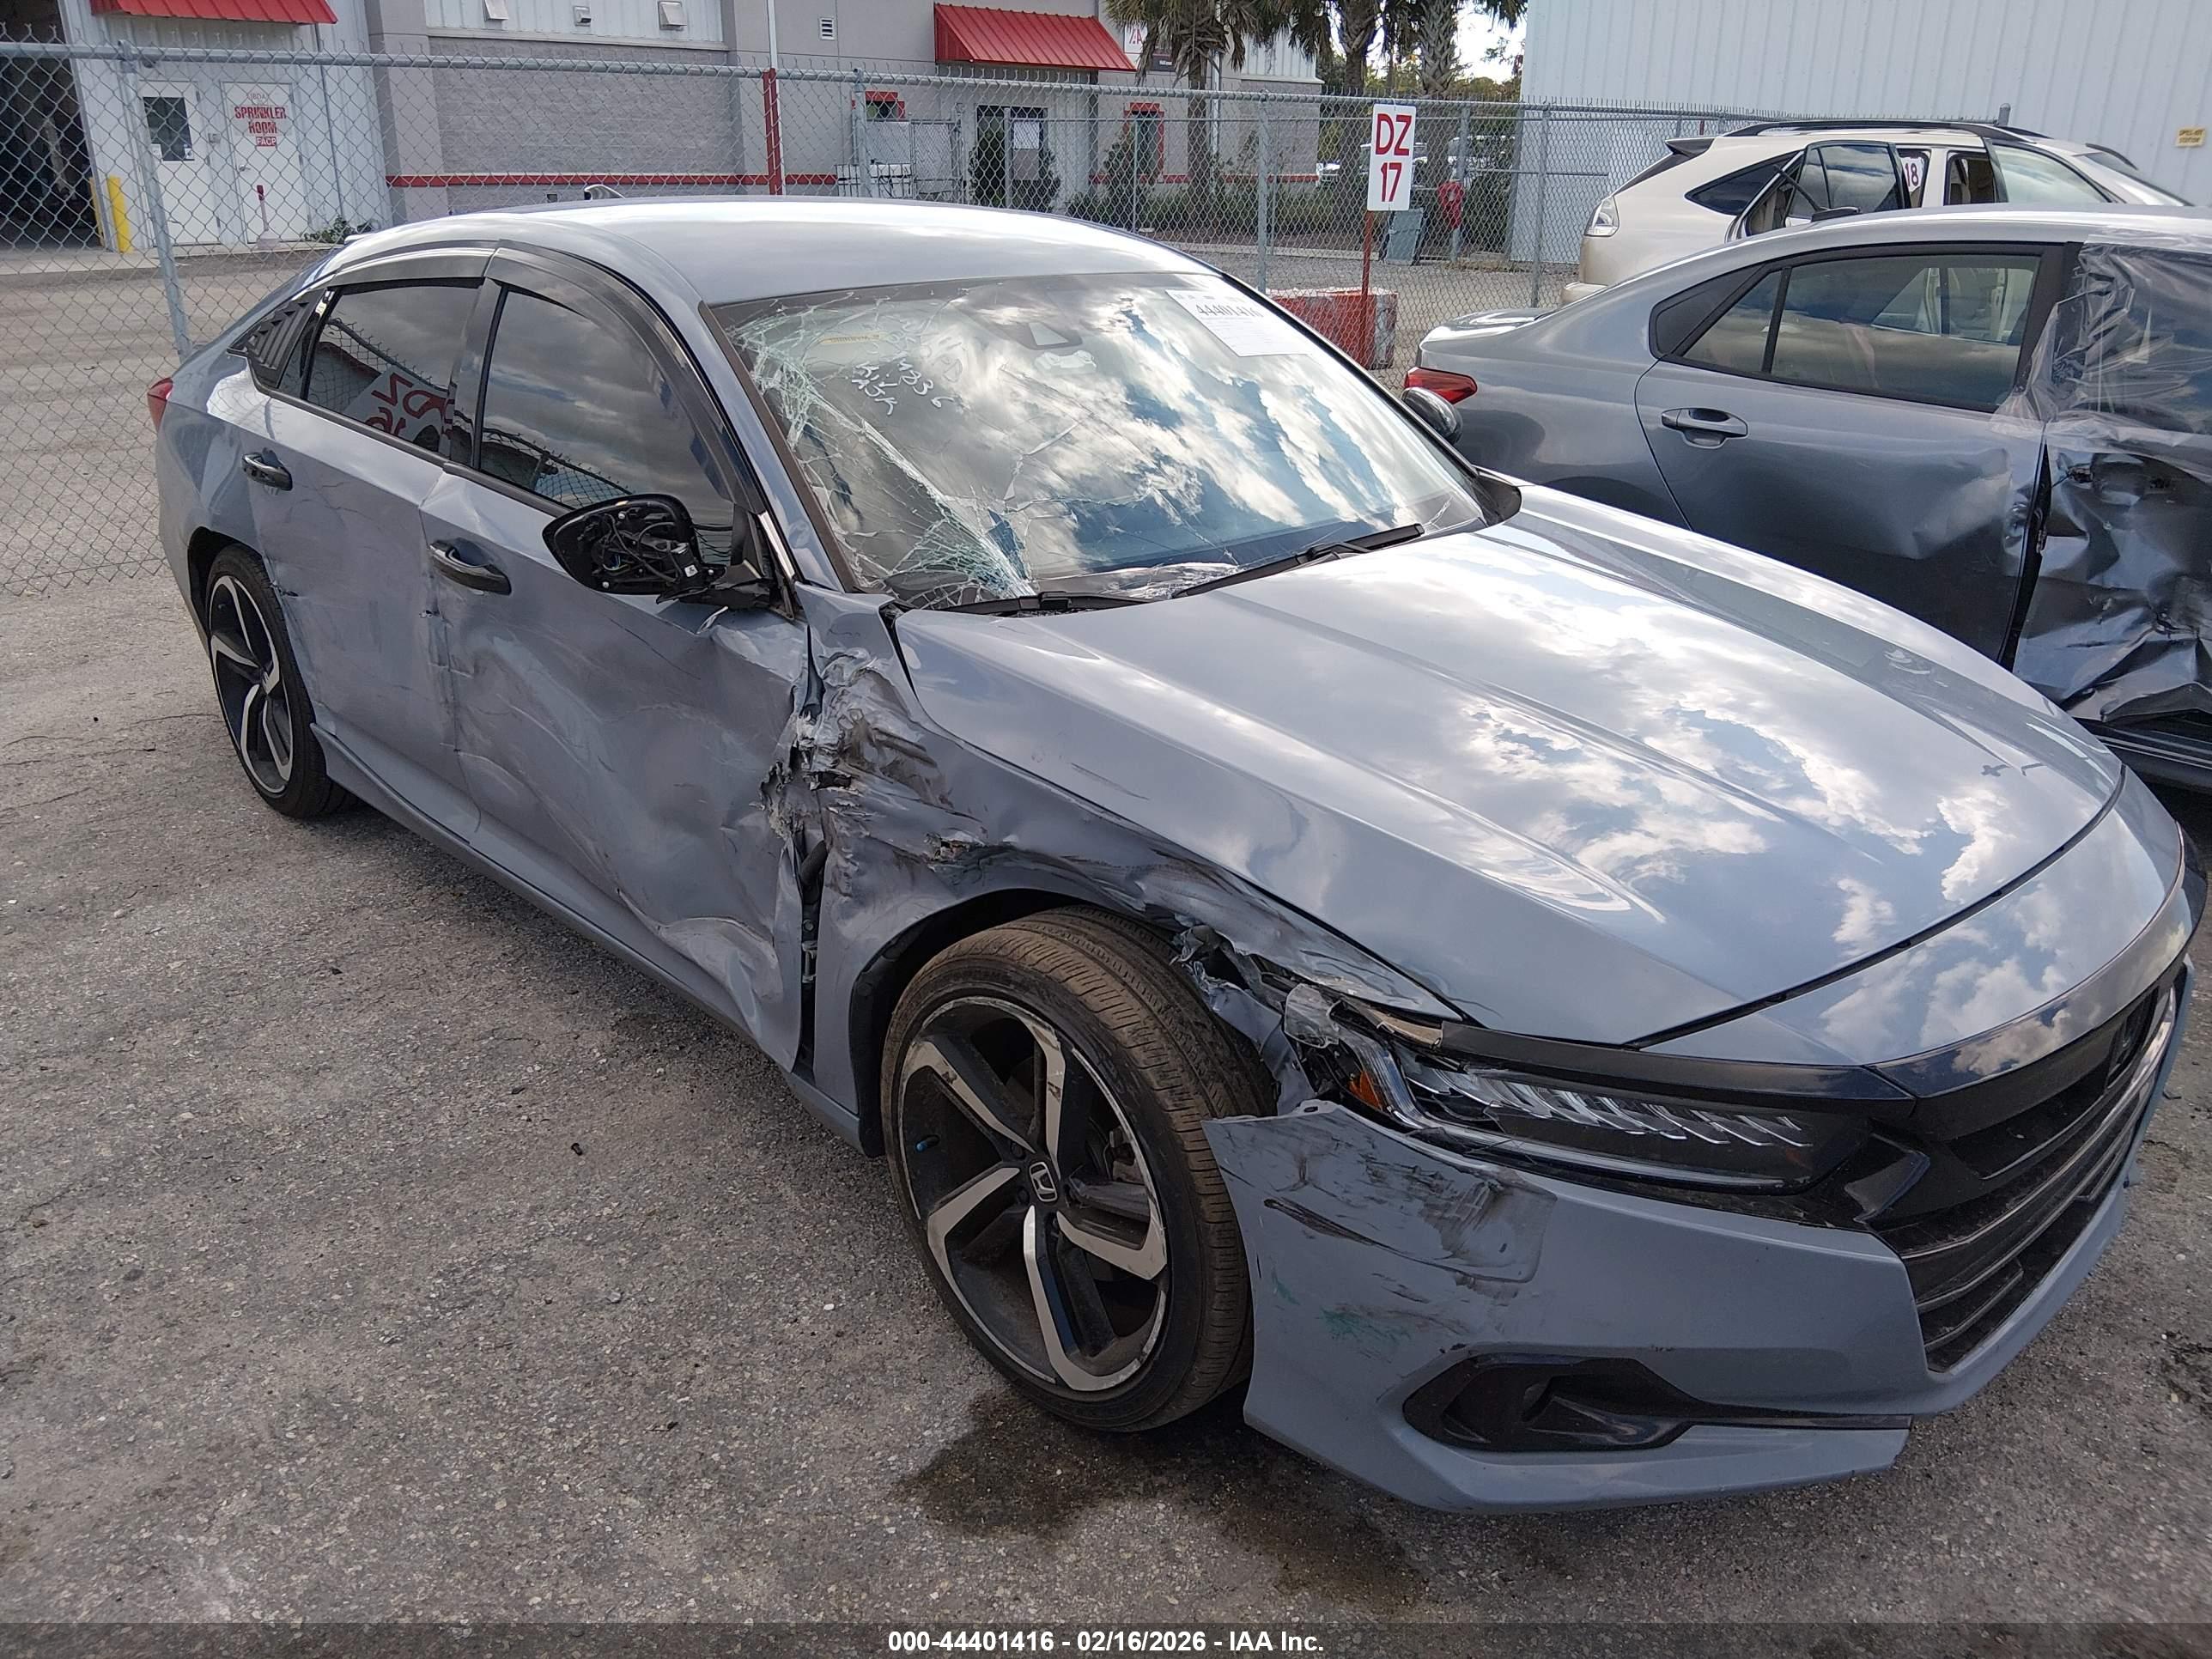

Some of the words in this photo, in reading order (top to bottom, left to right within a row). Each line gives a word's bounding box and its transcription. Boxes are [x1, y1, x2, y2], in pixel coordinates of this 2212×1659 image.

[234, 106, 287, 119] SPRINKLER
[248, 121, 277, 134] ROOM
[1376, 113, 1412, 155] DZ
[1381, 162, 1402, 203] 17
[1905, 162, 1919, 187] 18
